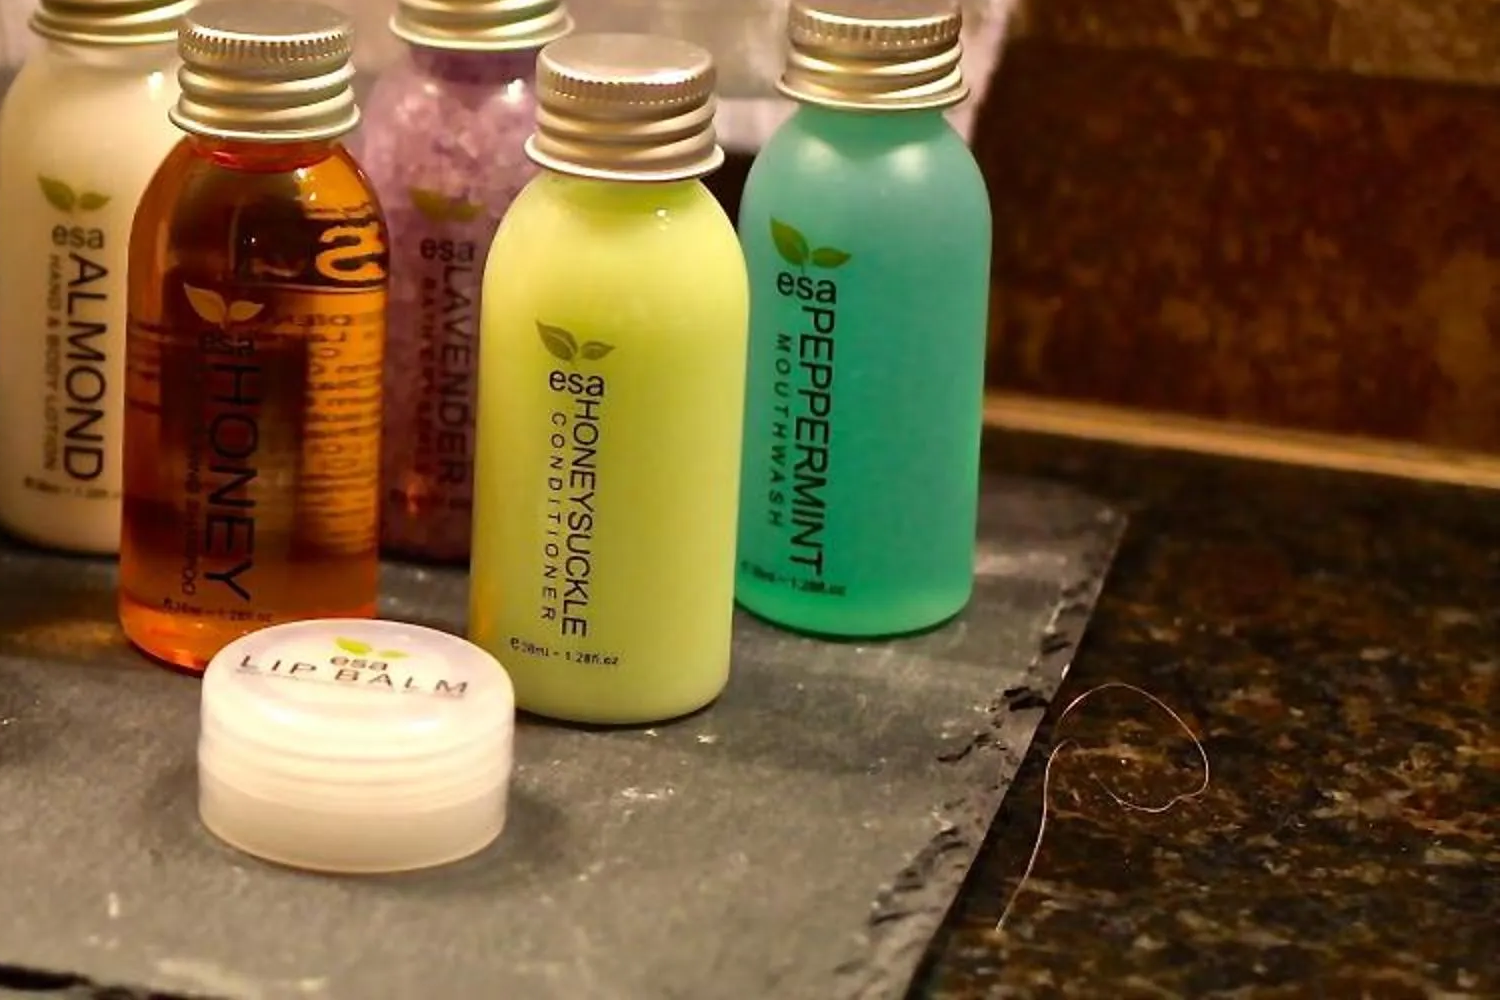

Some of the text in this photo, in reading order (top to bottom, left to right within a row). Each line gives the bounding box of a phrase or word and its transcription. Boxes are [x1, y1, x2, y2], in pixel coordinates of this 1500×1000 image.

[50, 224, 105, 250] esa
[420, 236, 475, 264] esa
[776, 271, 837, 304] esa
[63, 251, 109, 481] ALMOND
[435, 265, 472, 485] LAVENDER
[549, 370, 605, 397] esa
[767, 332, 793, 527] MOUTHWASH
[788, 304, 835, 576] PEPPERMINT
[204, 362, 262, 602] HONEY
[540, 411, 566, 621] CONDITIONER
[561, 398, 601, 638] HONEYSUCKLE
[240, 655, 468, 695] LIP BALM
